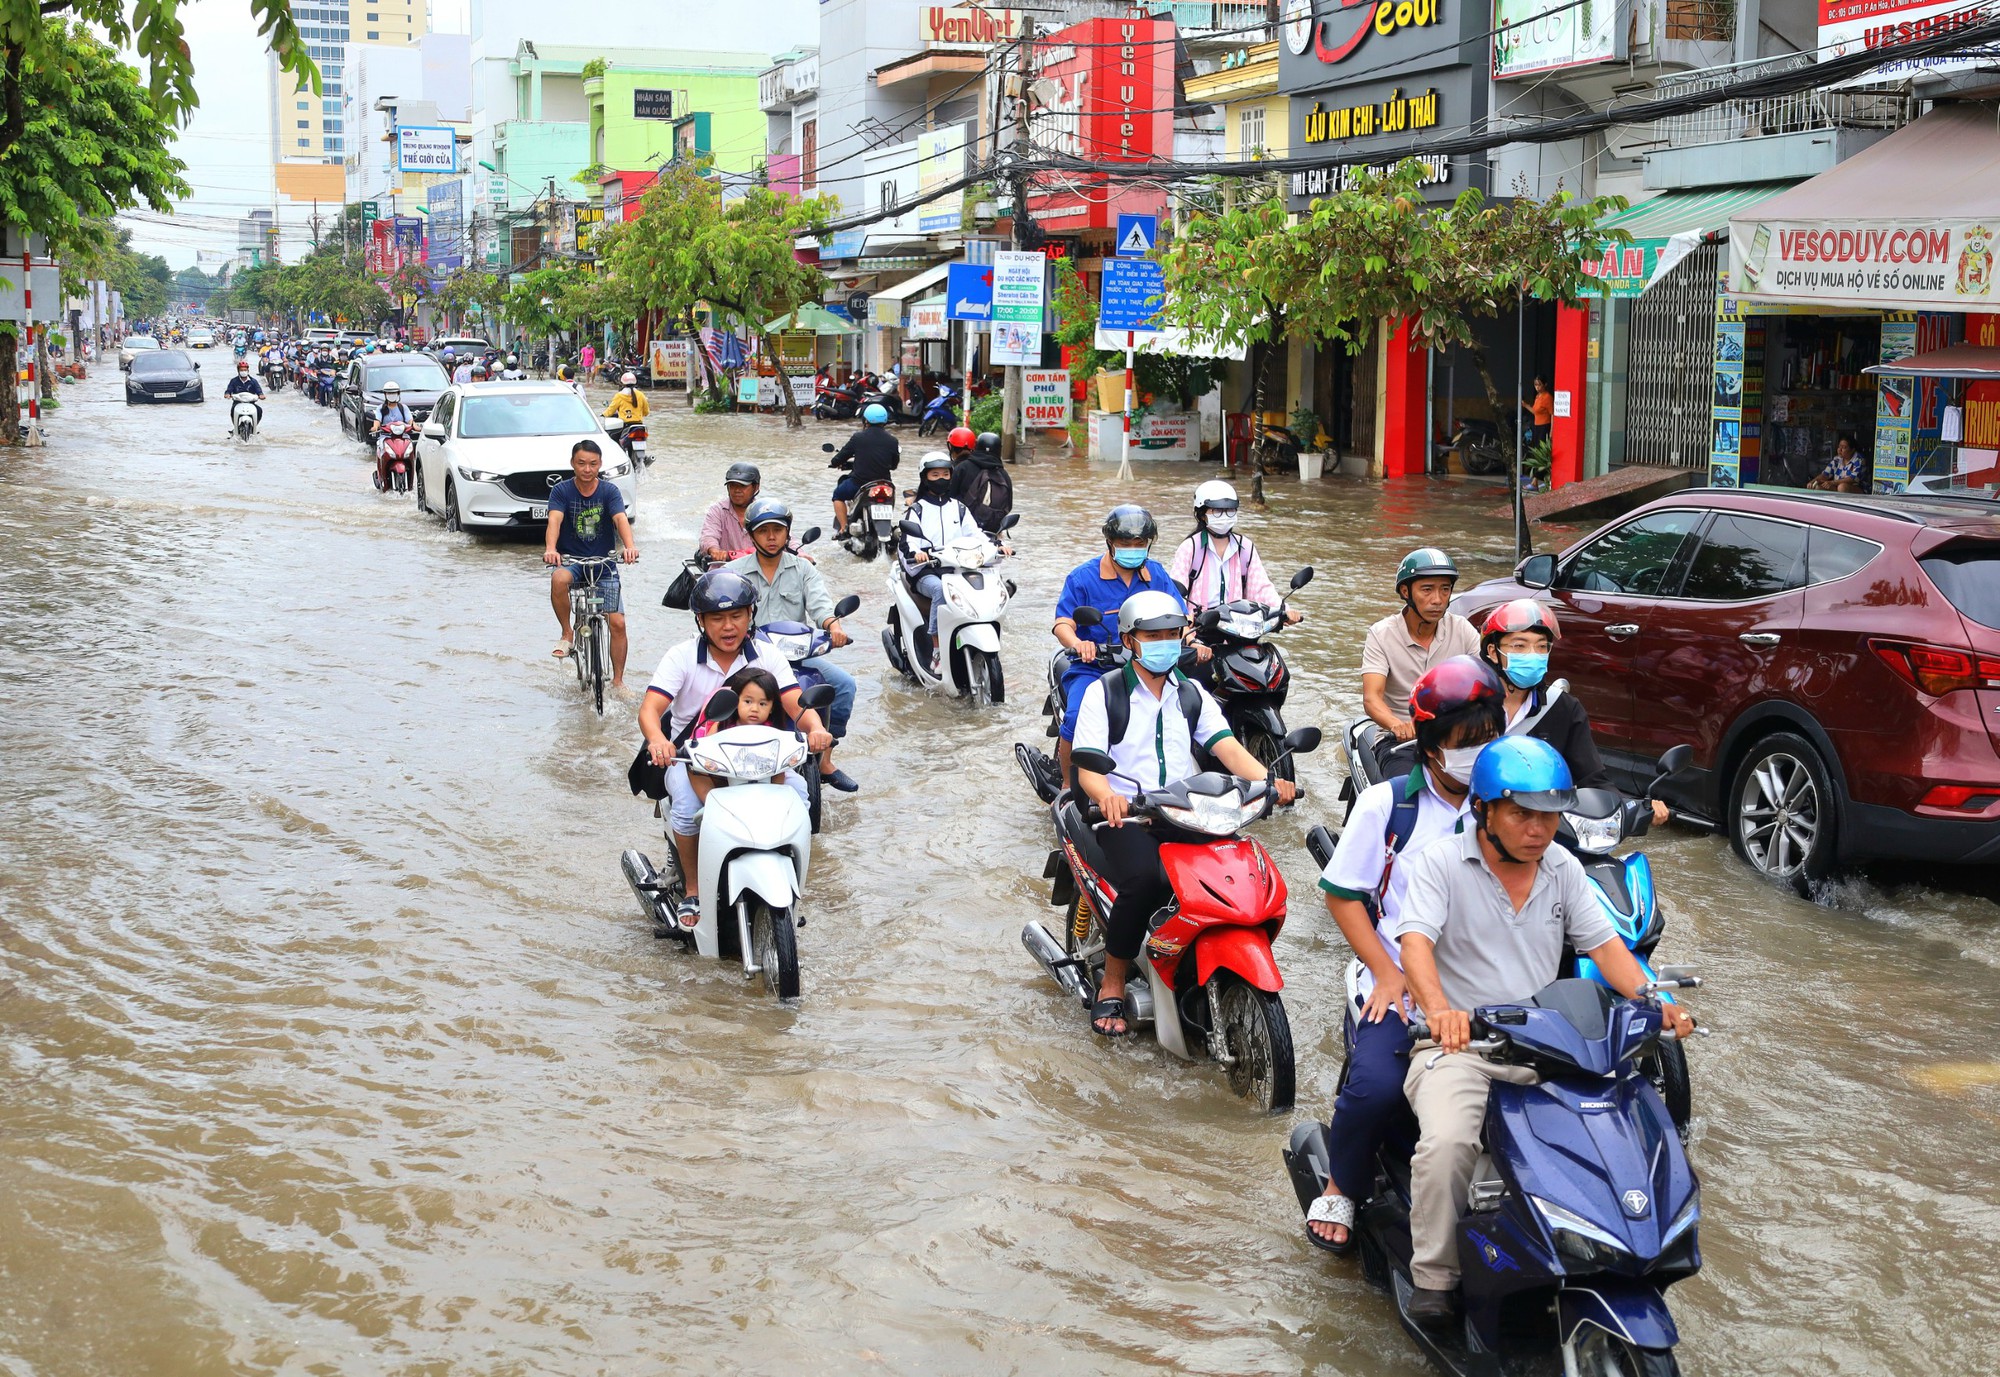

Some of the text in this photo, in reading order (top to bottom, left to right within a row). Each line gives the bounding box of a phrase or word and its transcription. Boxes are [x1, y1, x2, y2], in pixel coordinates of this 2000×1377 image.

[636, 92, 654, 102] NHÂN
[1305, 102, 1325, 143] LẨU
[1329, 108, 1350, 140] KIM
[1353, 104, 1374, 136] CHI
[1382, 88, 1405, 133] LẨU
[1409, 88, 1436, 129] THÁI
[1779, 228, 1951, 264] VESODUY.COM
[1776, 268, 1946, 293] DỊCH VỤ MUA HỘ VÉ SỐ ONLINE
[665, 342, 681, 350] NHÂN
[1026, 371, 1066, 382] CƠM TẤM
[1033, 383, 1056, 392] PHỞ
[1025, 406, 1065, 419] CHAY
[1214, 843, 1238, 852] HONDA
[1178, 915, 1200, 927] HONDA
[1580, 1101, 1617, 1109] HONDA
